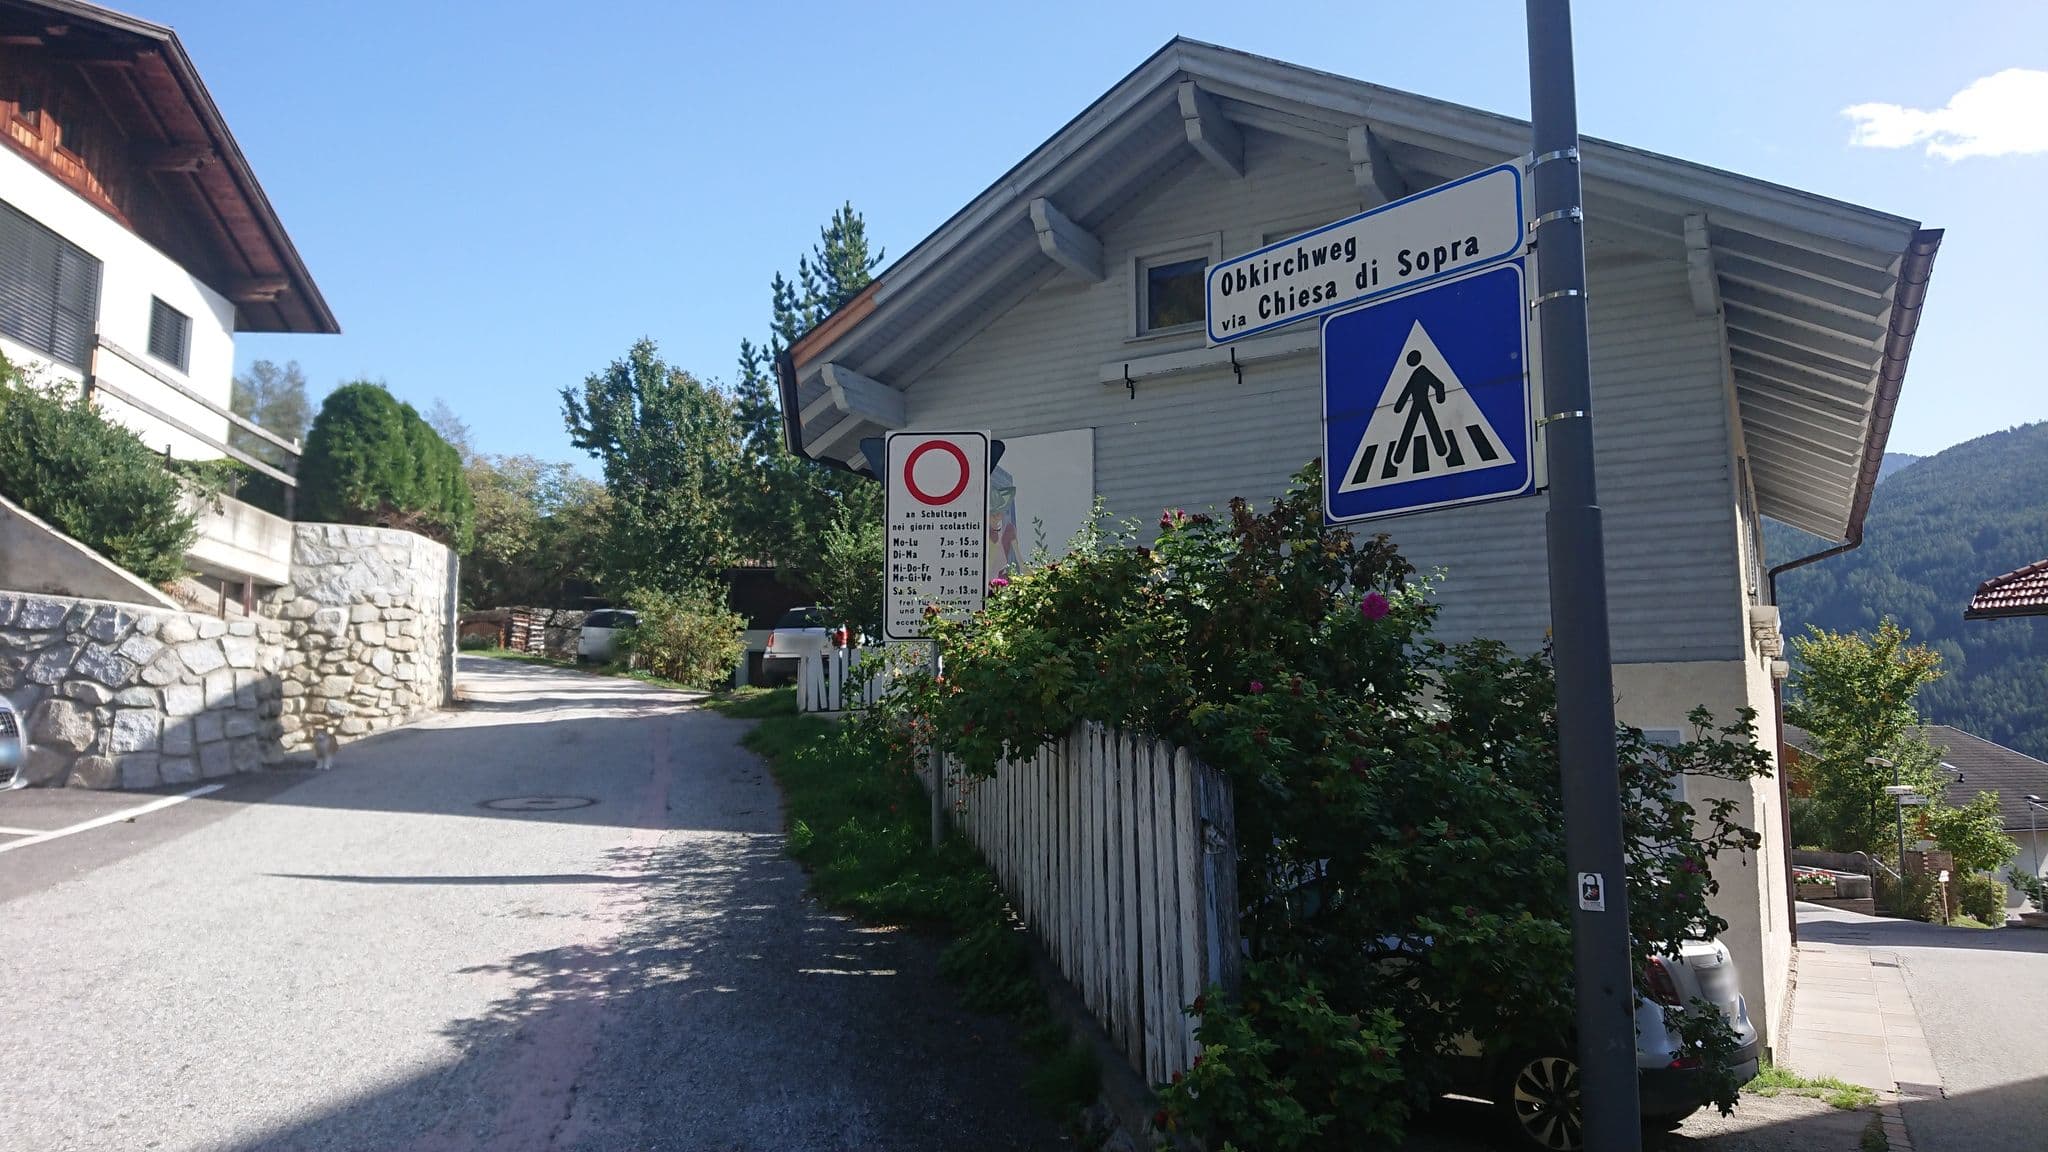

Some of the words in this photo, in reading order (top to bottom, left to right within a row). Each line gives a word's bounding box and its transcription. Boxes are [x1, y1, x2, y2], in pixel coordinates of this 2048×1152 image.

[1221, 236, 1357, 296] Obkirchweg
[1222, 313, 1247, 331] via
[1258, 279, 1338, 319] Chiesa
[1355, 260, 1379, 290] di
[1398, 236, 1479, 274] Sopra
[921, 510, 967, 519] Schultagen
[892, 522, 905, 531] nei
[910, 522, 935, 532] giorni
[940, 522, 980, 530] scolastici
[893, 537, 918, 547] Mo-Lu
[893, 550, 918, 559] Di-Ma
[893, 563, 930, 573] Mi-Do-Fr
[893, 573, 932, 582] Me-Gi-Ve
